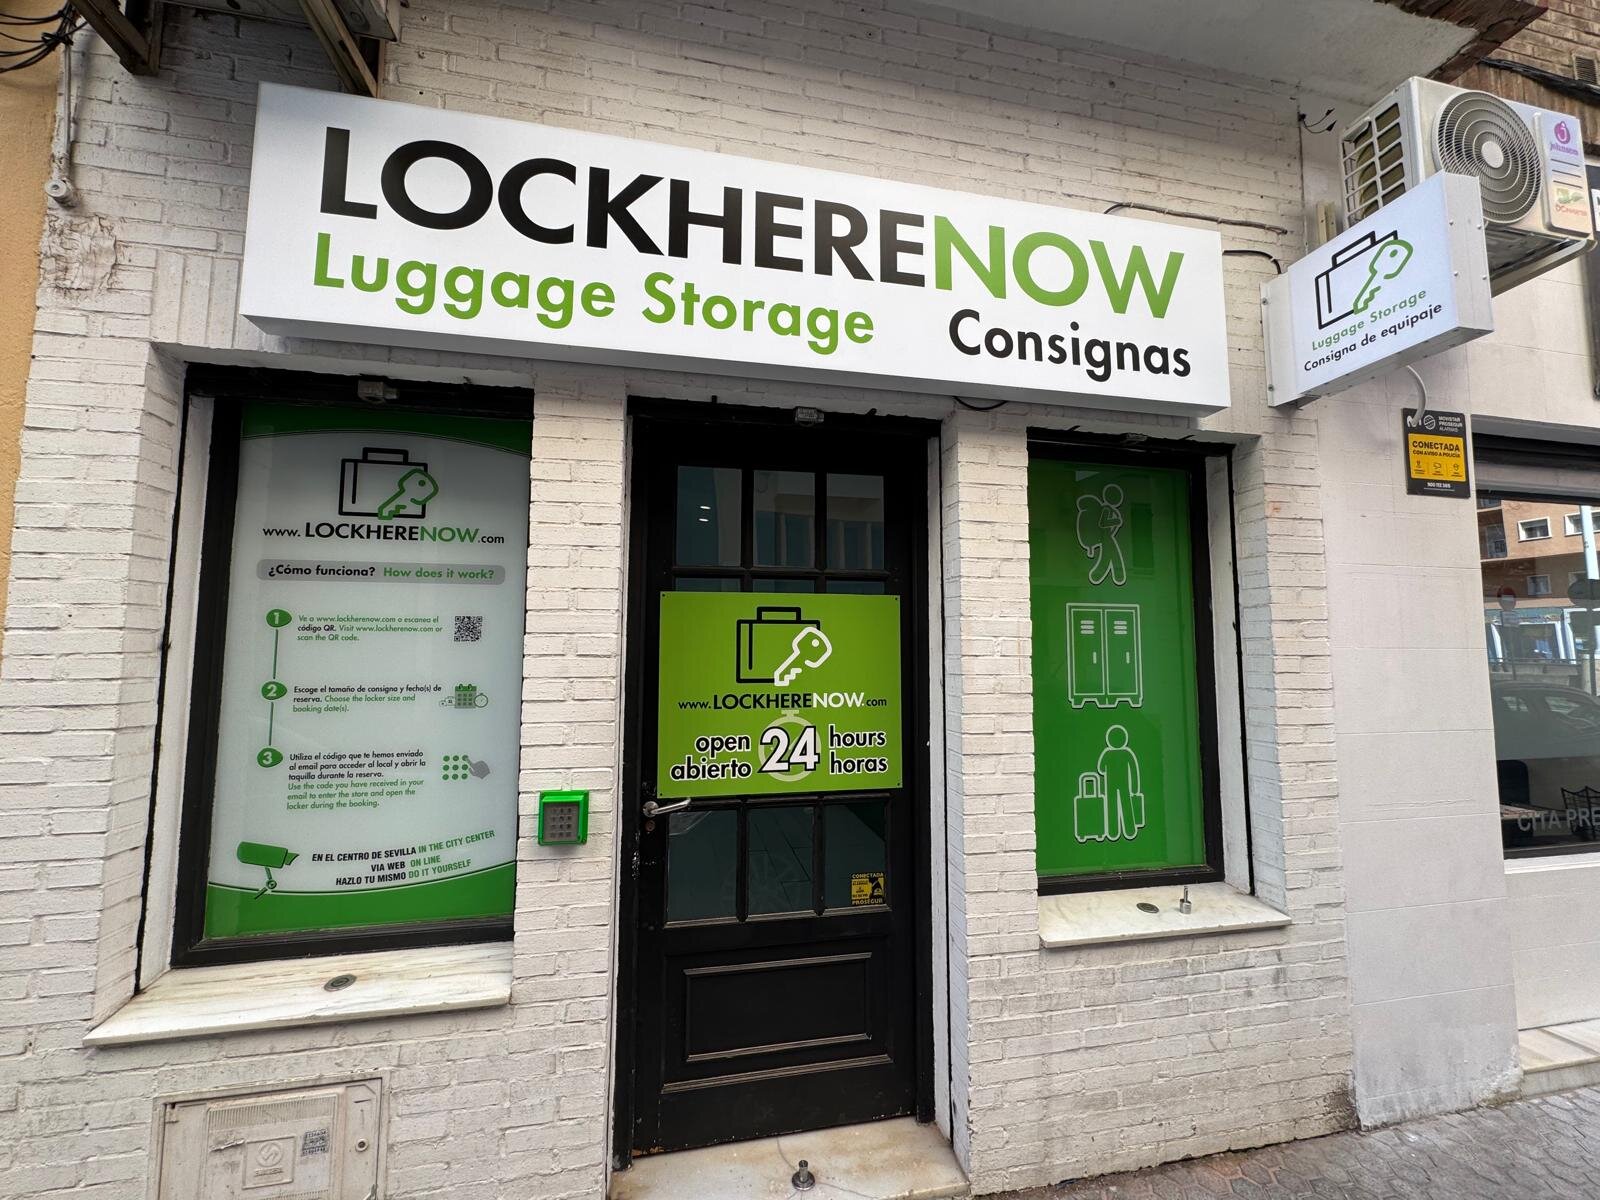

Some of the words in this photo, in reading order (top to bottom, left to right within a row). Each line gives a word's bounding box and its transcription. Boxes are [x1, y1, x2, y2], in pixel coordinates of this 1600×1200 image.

[320, 127, 1184, 319] LOCKHERENOW
[313, 232, 615, 329] Luggage
[641, 271, 874, 355] Storage
[1312, 321, 1365, 351] Luggage
[1370, 290, 1426, 322] Storage
[1304, 343, 1357, 371] Consigna
[1360, 332, 1377, 347] de
[1381, 304, 1442, 338] equipaje
[949, 308, 1191, 382] Consignas
[1412, 441, 1460, 452] CONECTADA
[268, 564, 312, 578] ¿Cómo
[315, 565, 376, 578] funciona?
[383, 567, 411, 578] How
[415, 567, 443, 579] does
[446, 567, 454, 578] it
[458, 568, 495, 580] work?
[273, 612, 280, 624] 1
[316, 615, 396, 623] www.lockherenow.com
[297, 624, 322, 633] código
[356, 625, 434, 633] www.lockherenow.com
[266, 685, 277, 697] 2
[294, 686, 319, 695] Escoge
[328, 685, 355, 693] tamaño
[357, 685, 366, 693] de
[367, 685, 398, 694] consigna
[406, 684, 432, 693] fecha(s)
[293, 695, 323, 703] reserva.
[364, 694, 385, 702] locker
[387, 694, 400, 702] size
[402, 694, 416, 702] and
[293, 705, 322, 714] booking
[323, 704, 350, 713] date(s).
[694, 734, 751, 759] open
[758, 725, 821, 774] 24
[828, 723, 886, 749] hours
[262, 752, 273, 764] 3
[290, 753, 313, 761] Utiliza
[323, 751, 347, 761] código
[348, 753, 361, 761] que
[372, 751, 394, 759] hemos
[396, 750, 424, 758] enviado
[289, 763, 297, 771] al
[298, 762, 318, 770] email
[319, 763, 336, 771] para
[339, 761, 366, 769] acceder
[367, 760, 375, 768] al
[377, 760, 393, 768] local
[401, 759, 418, 767] abrir
[419, 759, 426, 767] la
[670, 755, 752, 781] abierto
[829, 750, 888, 775] horas
[288, 773, 315, 782] taquilla
[317, 772, 345, 780] durante
[347, 771, 354, 779] la
[288, 783, 301, 791] Use
[316, 782, 334, 790] code
[335, 782, 348, 790] you
[370, 780, 398, 788] received
[408, 780, 424, 788] your
[287, 792, 307, 800] email
[318, 791, 337, 799] enter
[338, 790, 349, 798] the
[352, 790, 369, 798] store
[371, 789, 384, 797] and
[386, 789, 403, 798] open
[405, 788, 416, 796] the
[287, 802, 308, 810] locker
[310, 801, 334, 811] during
[336, 800, 347, 808] the
[350, 799, 380, 809] booking.
[1518, 809, 1561, 831] CITA
[312, 853, 323, 862] EN
[325, 852, 335, 861] EL
[337, 851, 370, 862] CENTRO
[372, 850, 382, 859] DE
[384, 846, 417, 858] SEVILLA
[418, 845, 426, 853] IN
[428, 841, 443, 851] THE
[446, 837, 464, 849] CITY
[465, 830, 495, 845] CENTER
[371, 863, 385, 872] VIA
[387, 861, 406, 870] WEB
[410, 858, 421, 868] ON
[423, 855, 441, 865] LINE
[336, 876, 362, 886] HAZLO
[365, 874, 376, 883] TU
[377, 871, 407, 882] MISMO
[408, 869, 420, 879] DO
[422, 867, 430, 876] IT
[432, 859, 472, 874] YOURSELF
